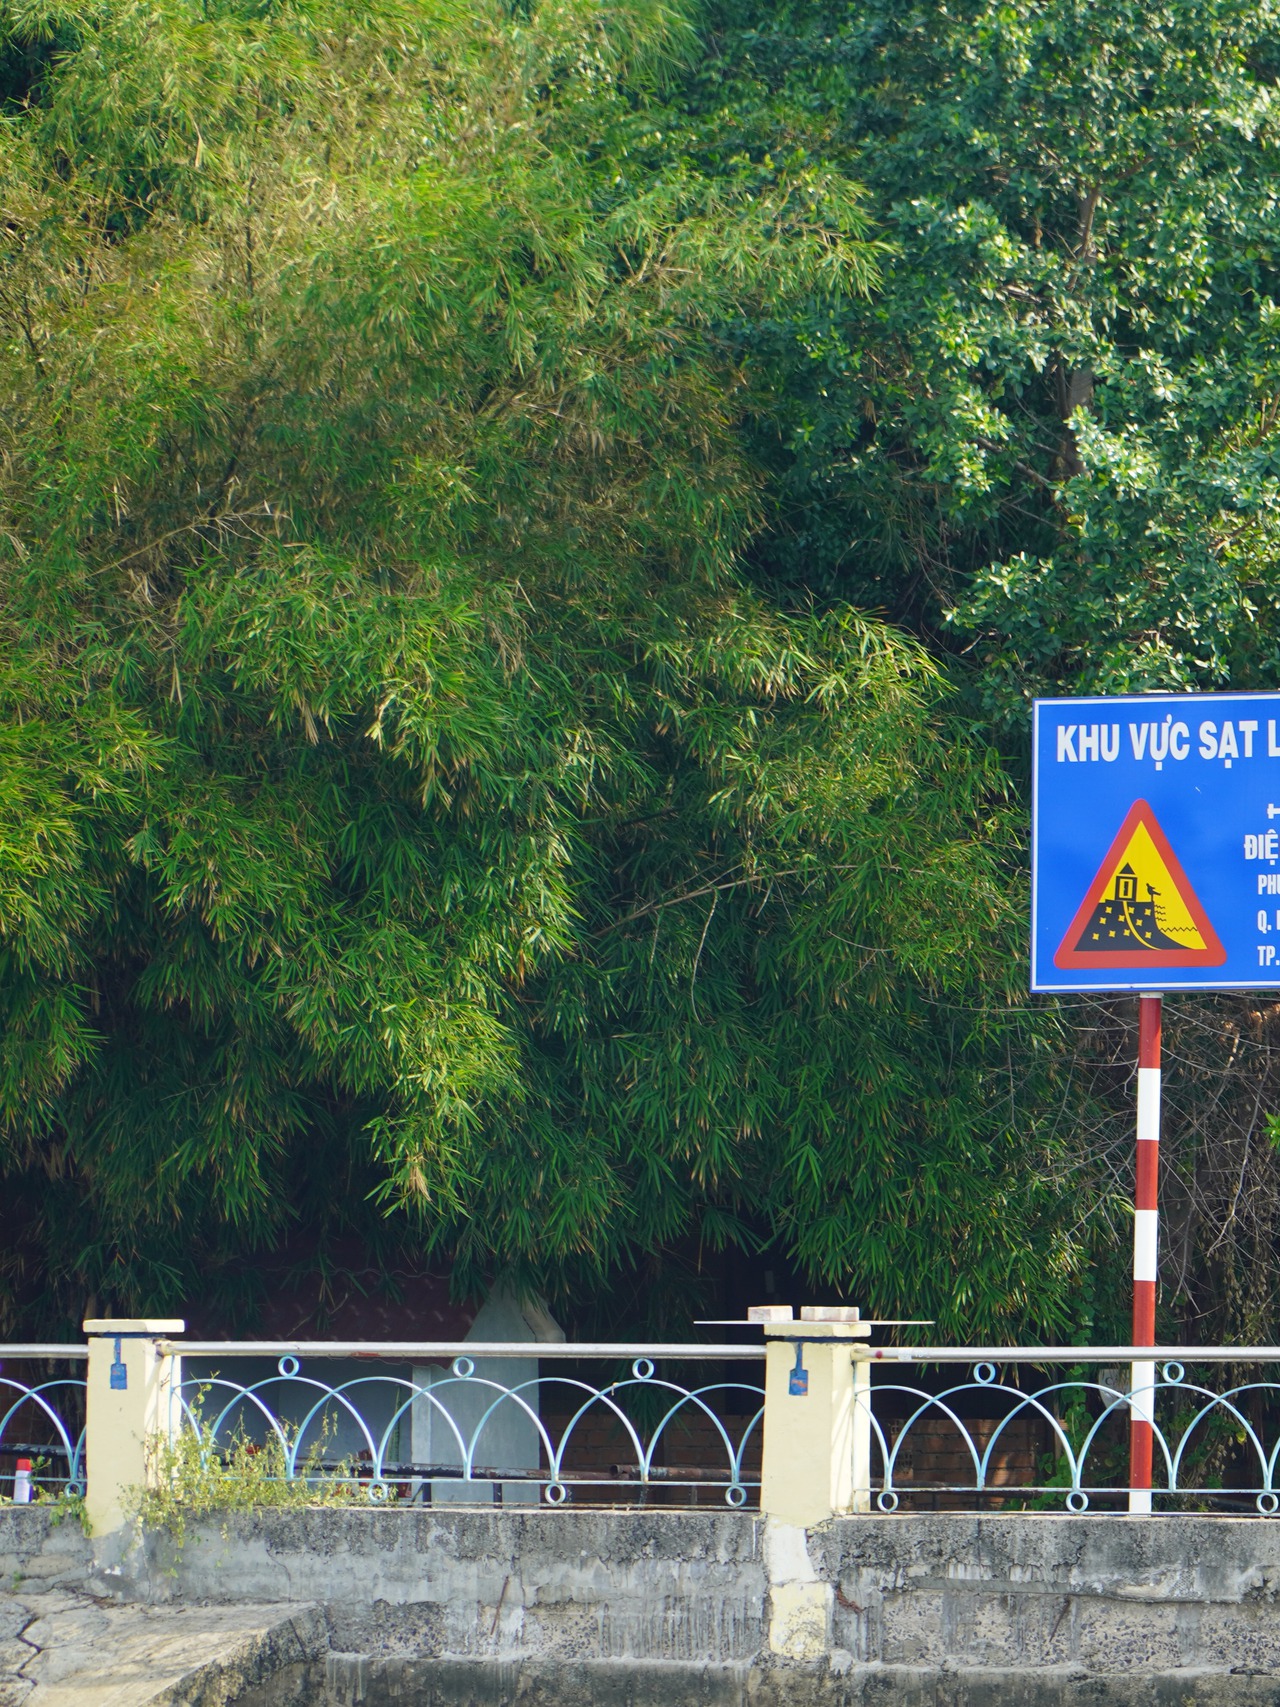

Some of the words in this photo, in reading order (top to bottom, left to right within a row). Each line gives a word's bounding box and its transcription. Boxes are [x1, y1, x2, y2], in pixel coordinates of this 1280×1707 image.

[1057, 724, 1119, 762] KHU
[1129, 714, 1190, 770] VỰC
[1199, 720, 1258, 768] SẠT
[1258, 910, 1271, 934] Q.
[1257, 946, 1280, 966] TP.
